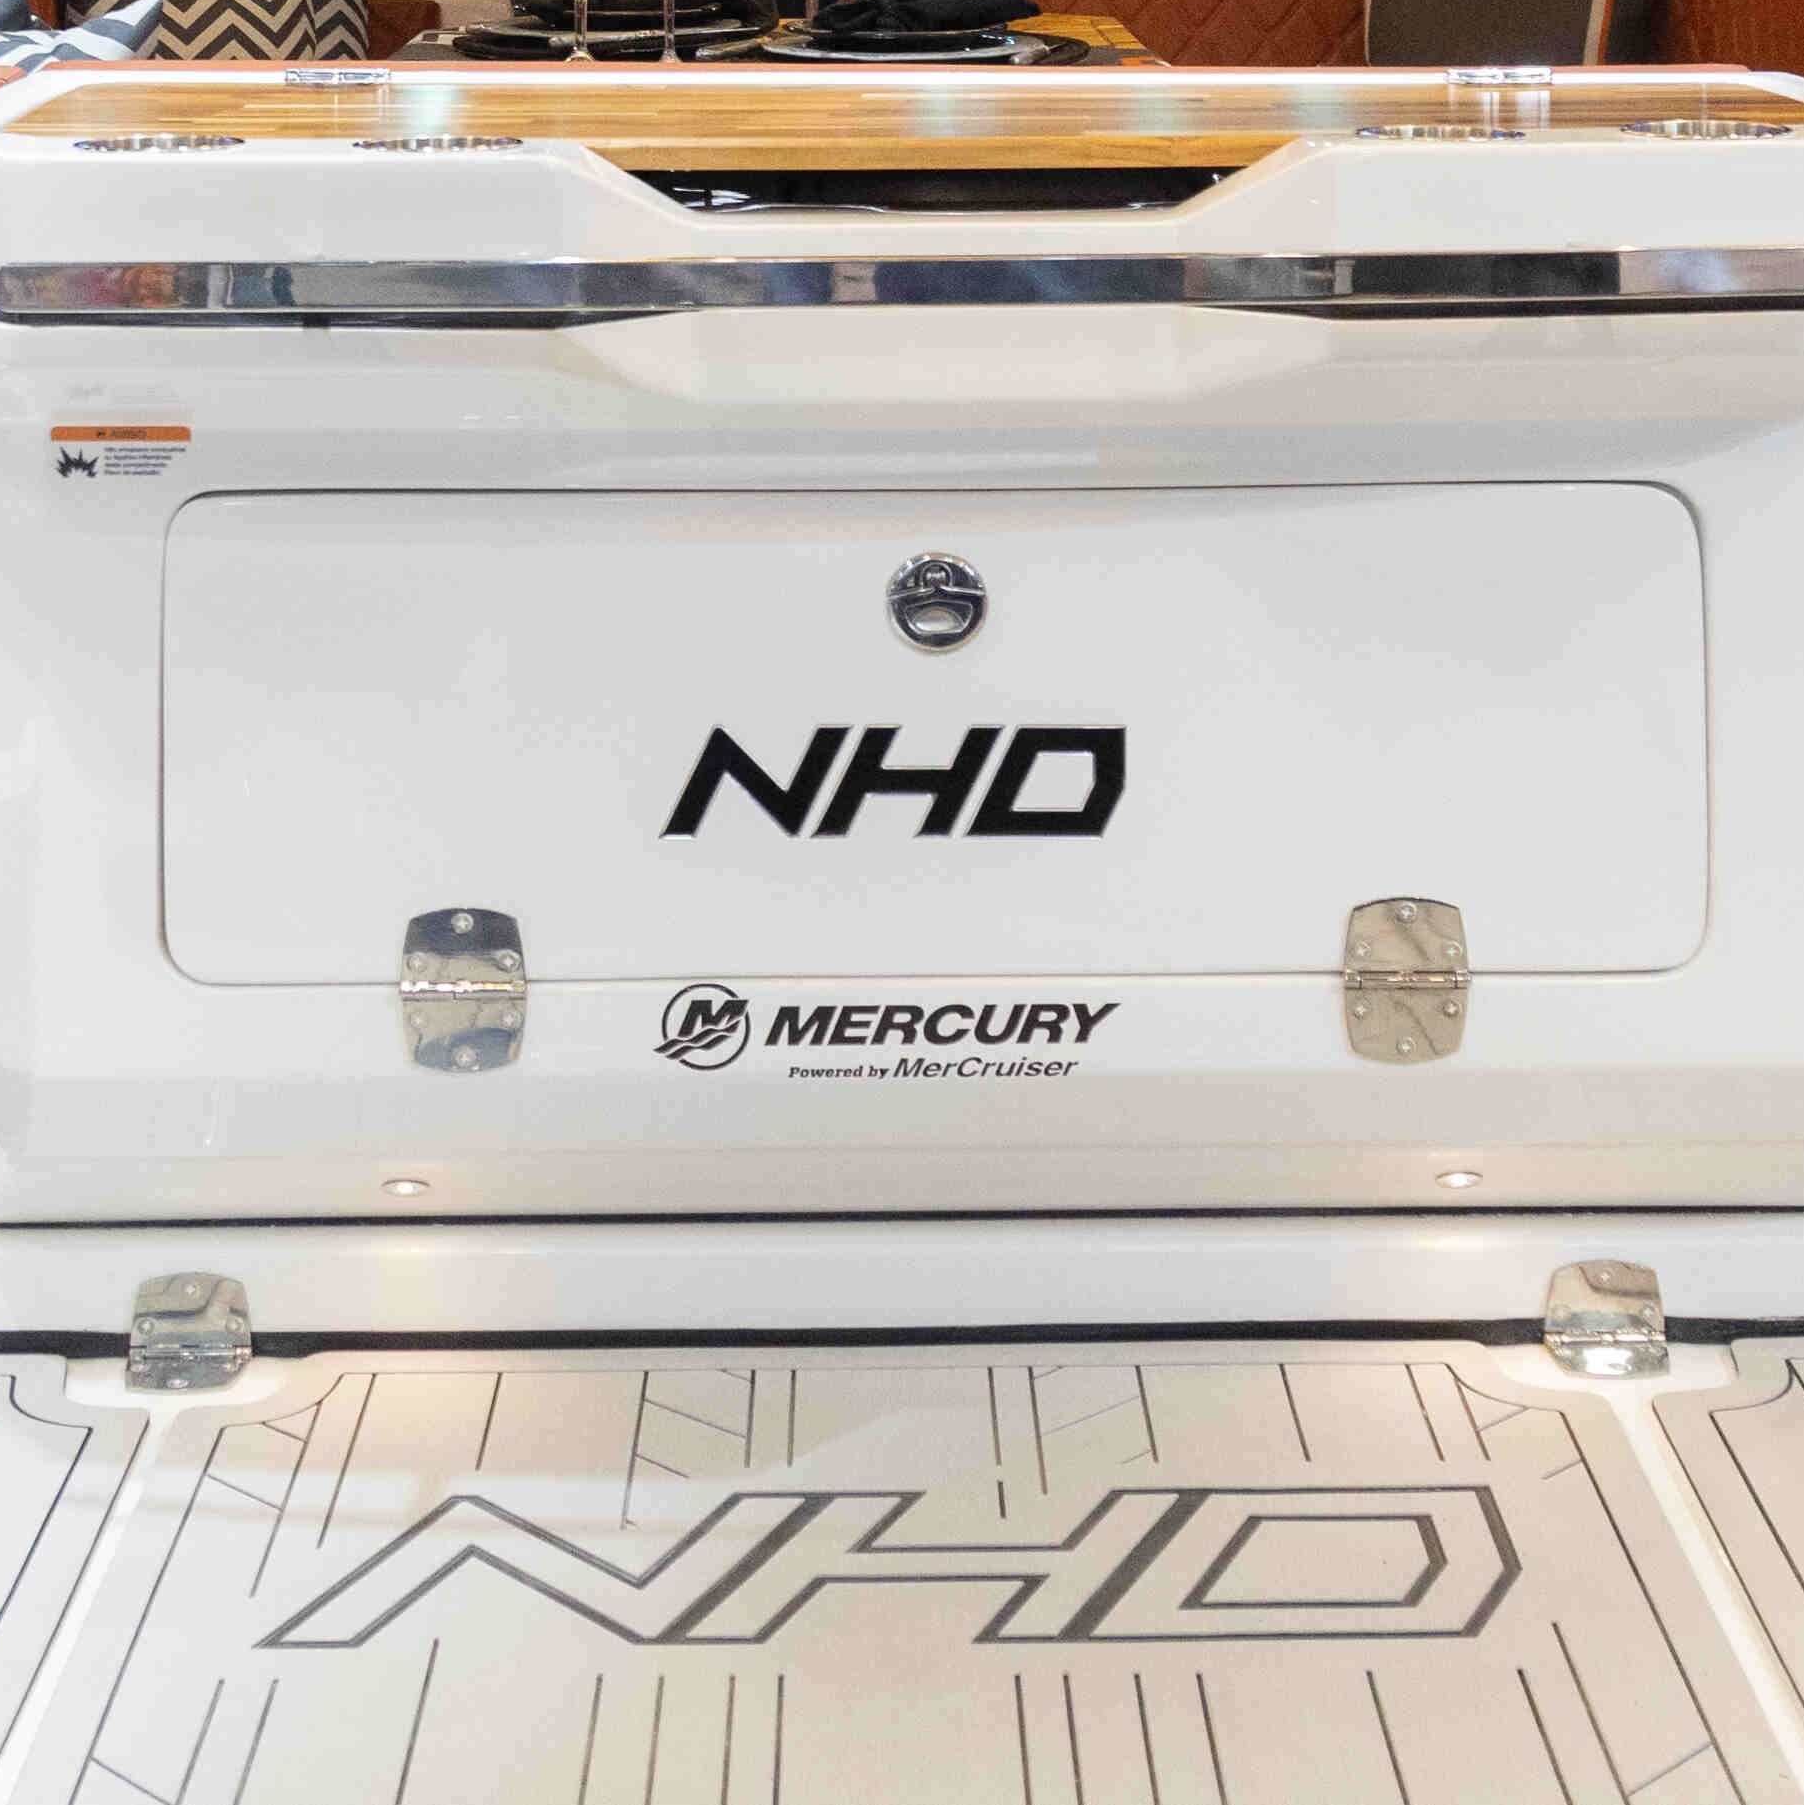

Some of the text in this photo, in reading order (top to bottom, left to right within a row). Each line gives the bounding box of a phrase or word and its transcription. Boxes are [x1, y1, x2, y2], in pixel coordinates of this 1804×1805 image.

[658, 724, 1127, 839] NHD
[764, 1001, 1123, 1046] MERCURY
[788, 1056, 1080, 1082] Powered by MerCruiser
[251, 1484, 1523, 1650] NHD
